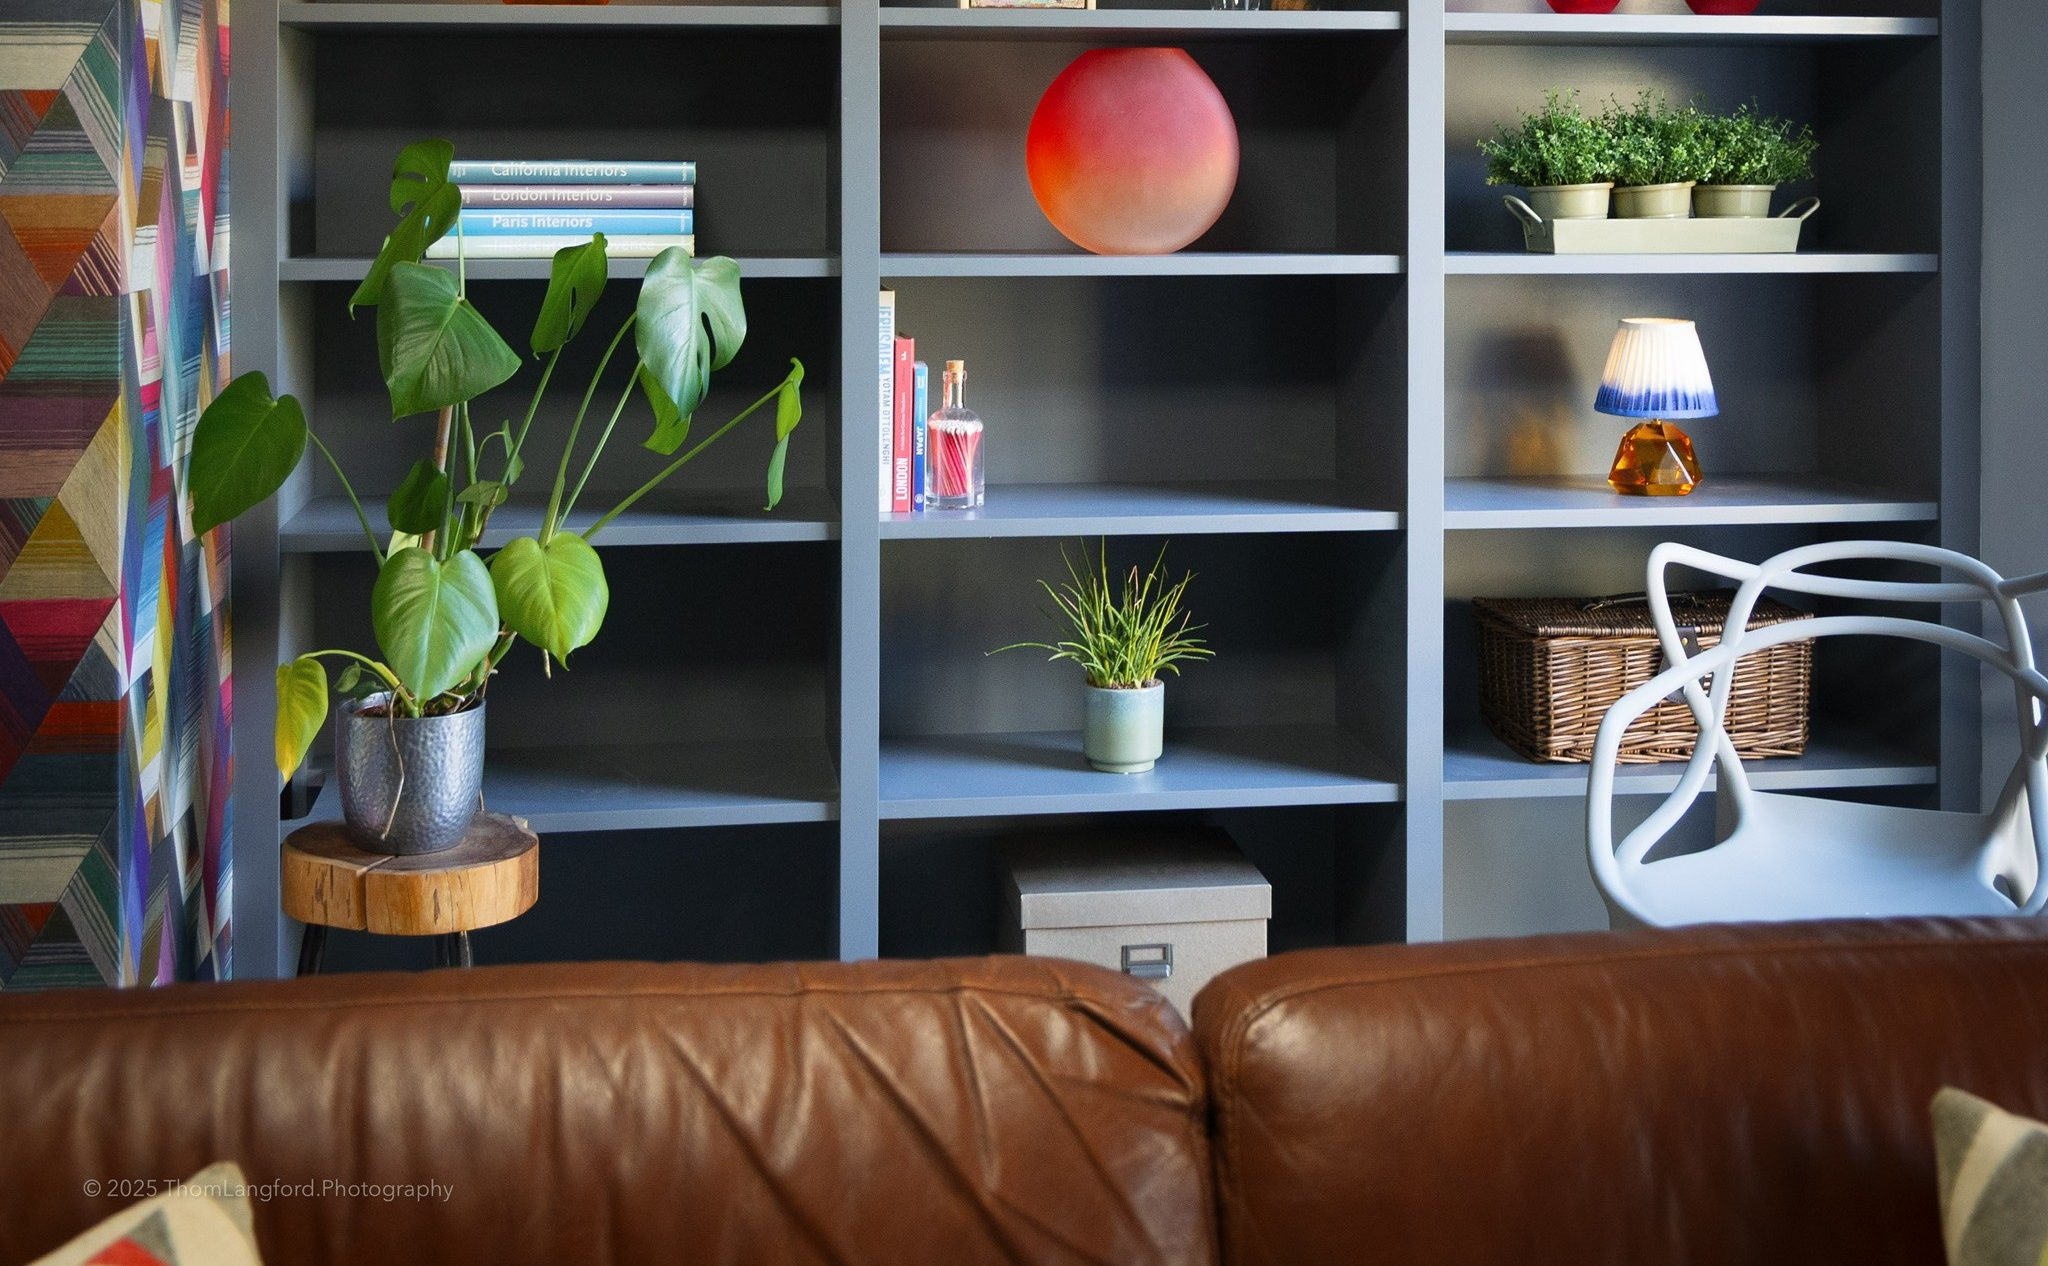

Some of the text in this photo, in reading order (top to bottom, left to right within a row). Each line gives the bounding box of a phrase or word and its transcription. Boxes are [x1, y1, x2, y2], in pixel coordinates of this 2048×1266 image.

[492, 161, 628, 177] California Interiors
[493, 187, 613, 201] London Interiors
[492, 215, 593, 229] Paris Interiors
[882, 378, 891, 465] YOTAM OTTOLENGHI
[915, 426, 924, 456] JAPAN
[896, 457, 908, 501] LONDON
